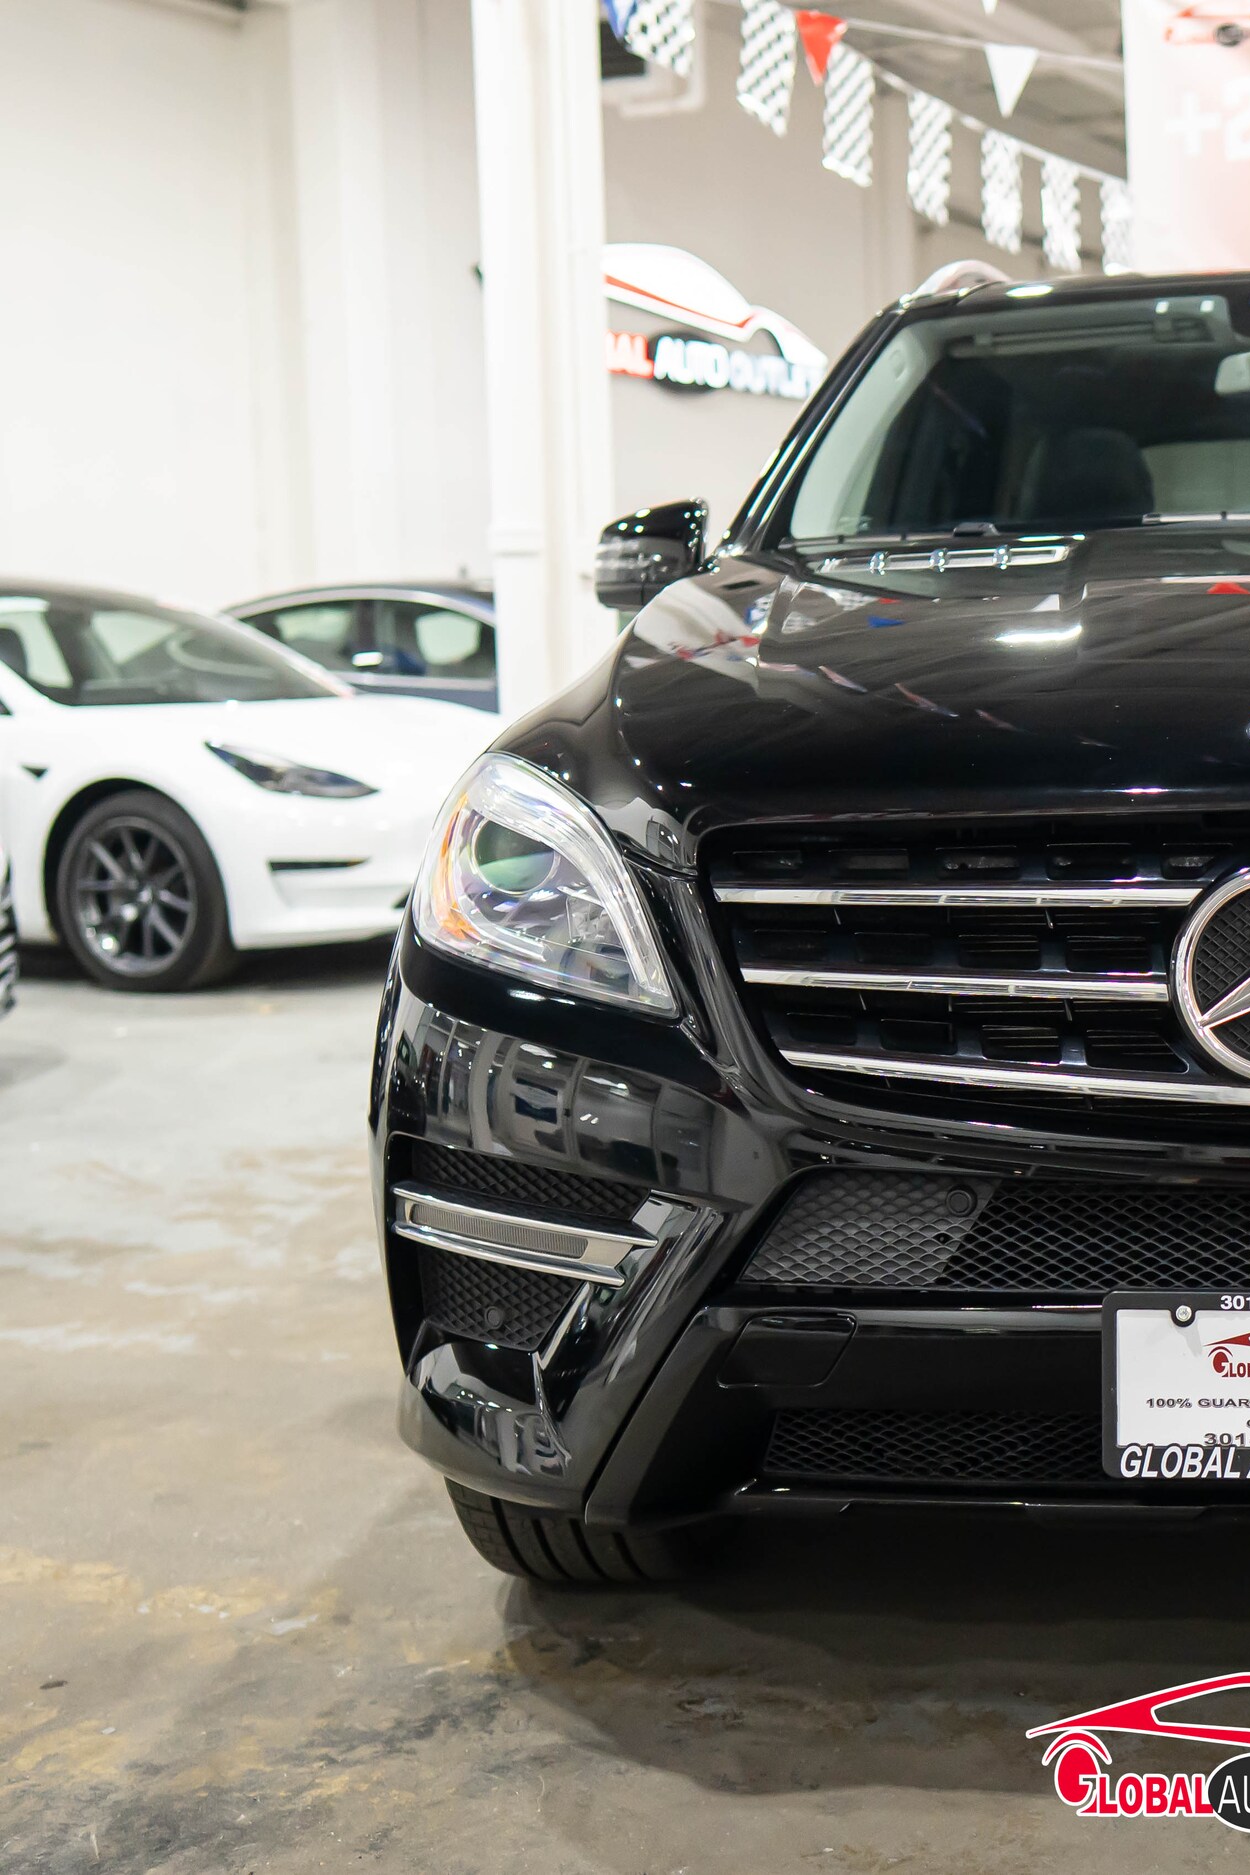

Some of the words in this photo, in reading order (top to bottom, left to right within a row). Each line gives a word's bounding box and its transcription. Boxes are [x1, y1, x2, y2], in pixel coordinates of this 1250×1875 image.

[654, 335, 730, 389] AUTO
[1146, 1398, 1192, 1409] 100%
[1120, 1446, 1241, 1479] GLOBAL
